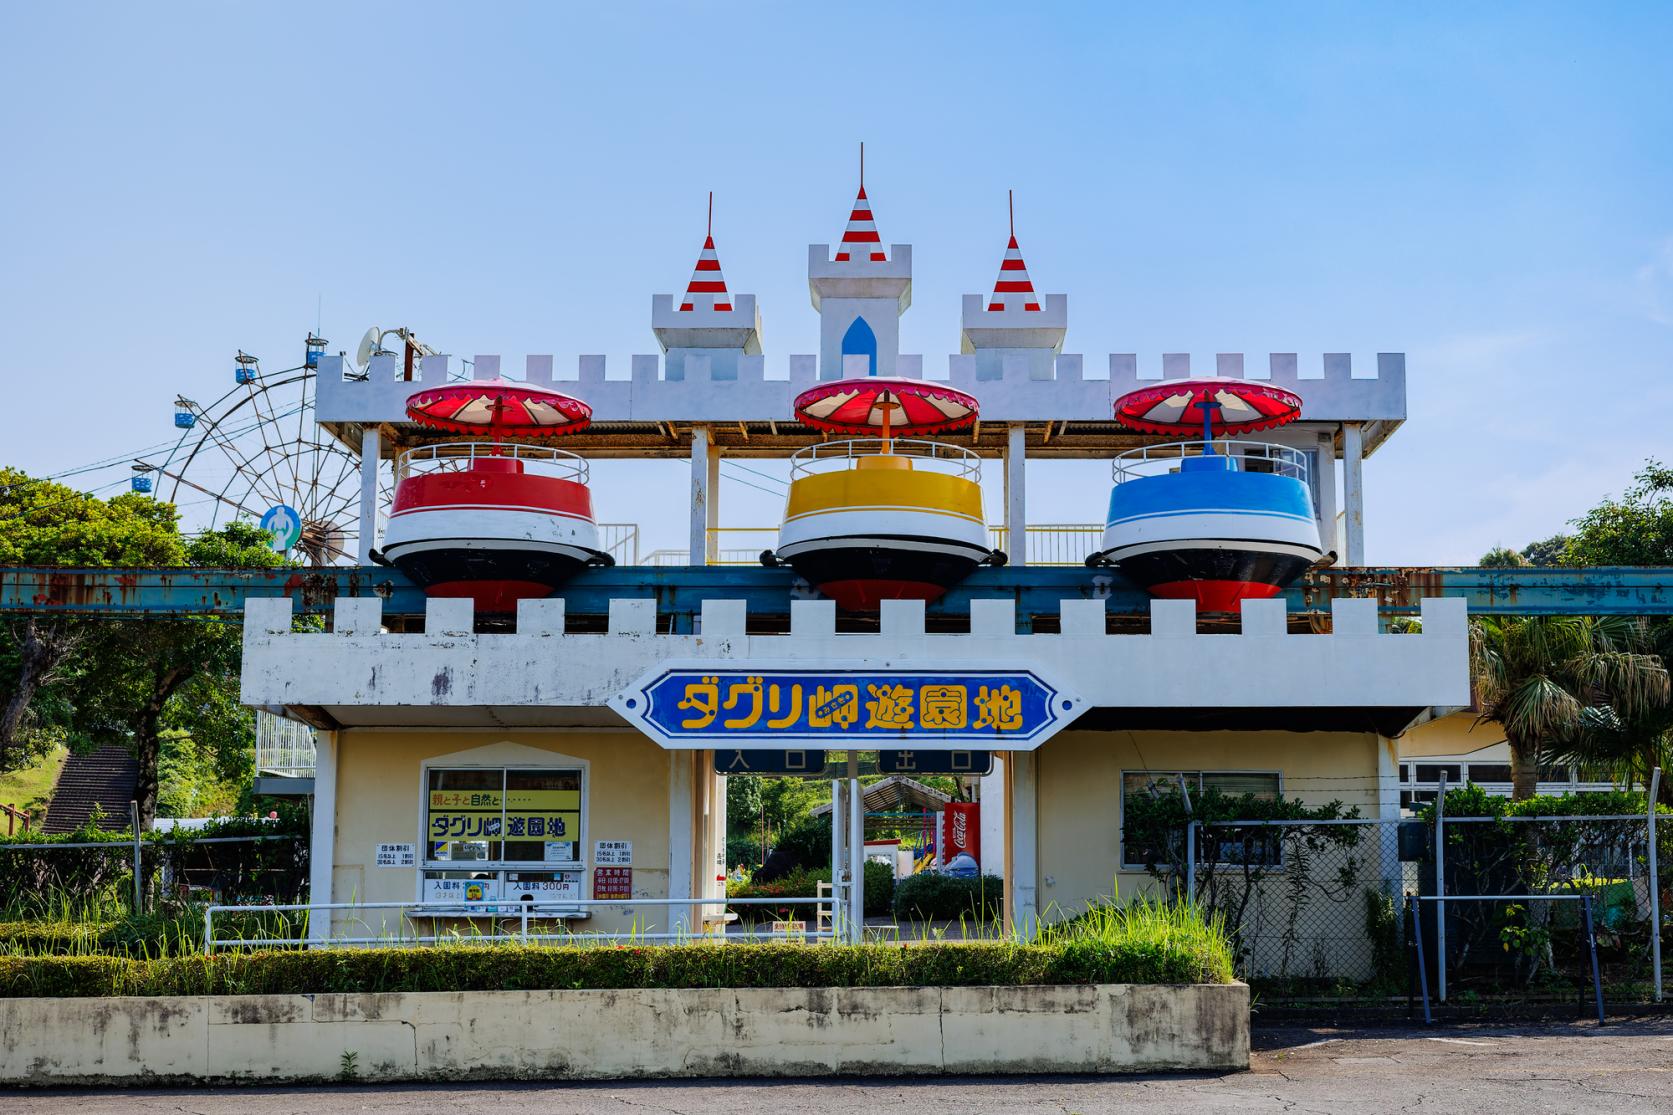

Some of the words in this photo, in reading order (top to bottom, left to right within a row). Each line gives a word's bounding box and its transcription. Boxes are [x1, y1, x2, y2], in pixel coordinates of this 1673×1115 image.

[677, 676, 1023, 730] ダグリ岬遊園地
[513, 880, 540, 890] 入園料
[542, 880, 570, 891] 300円
